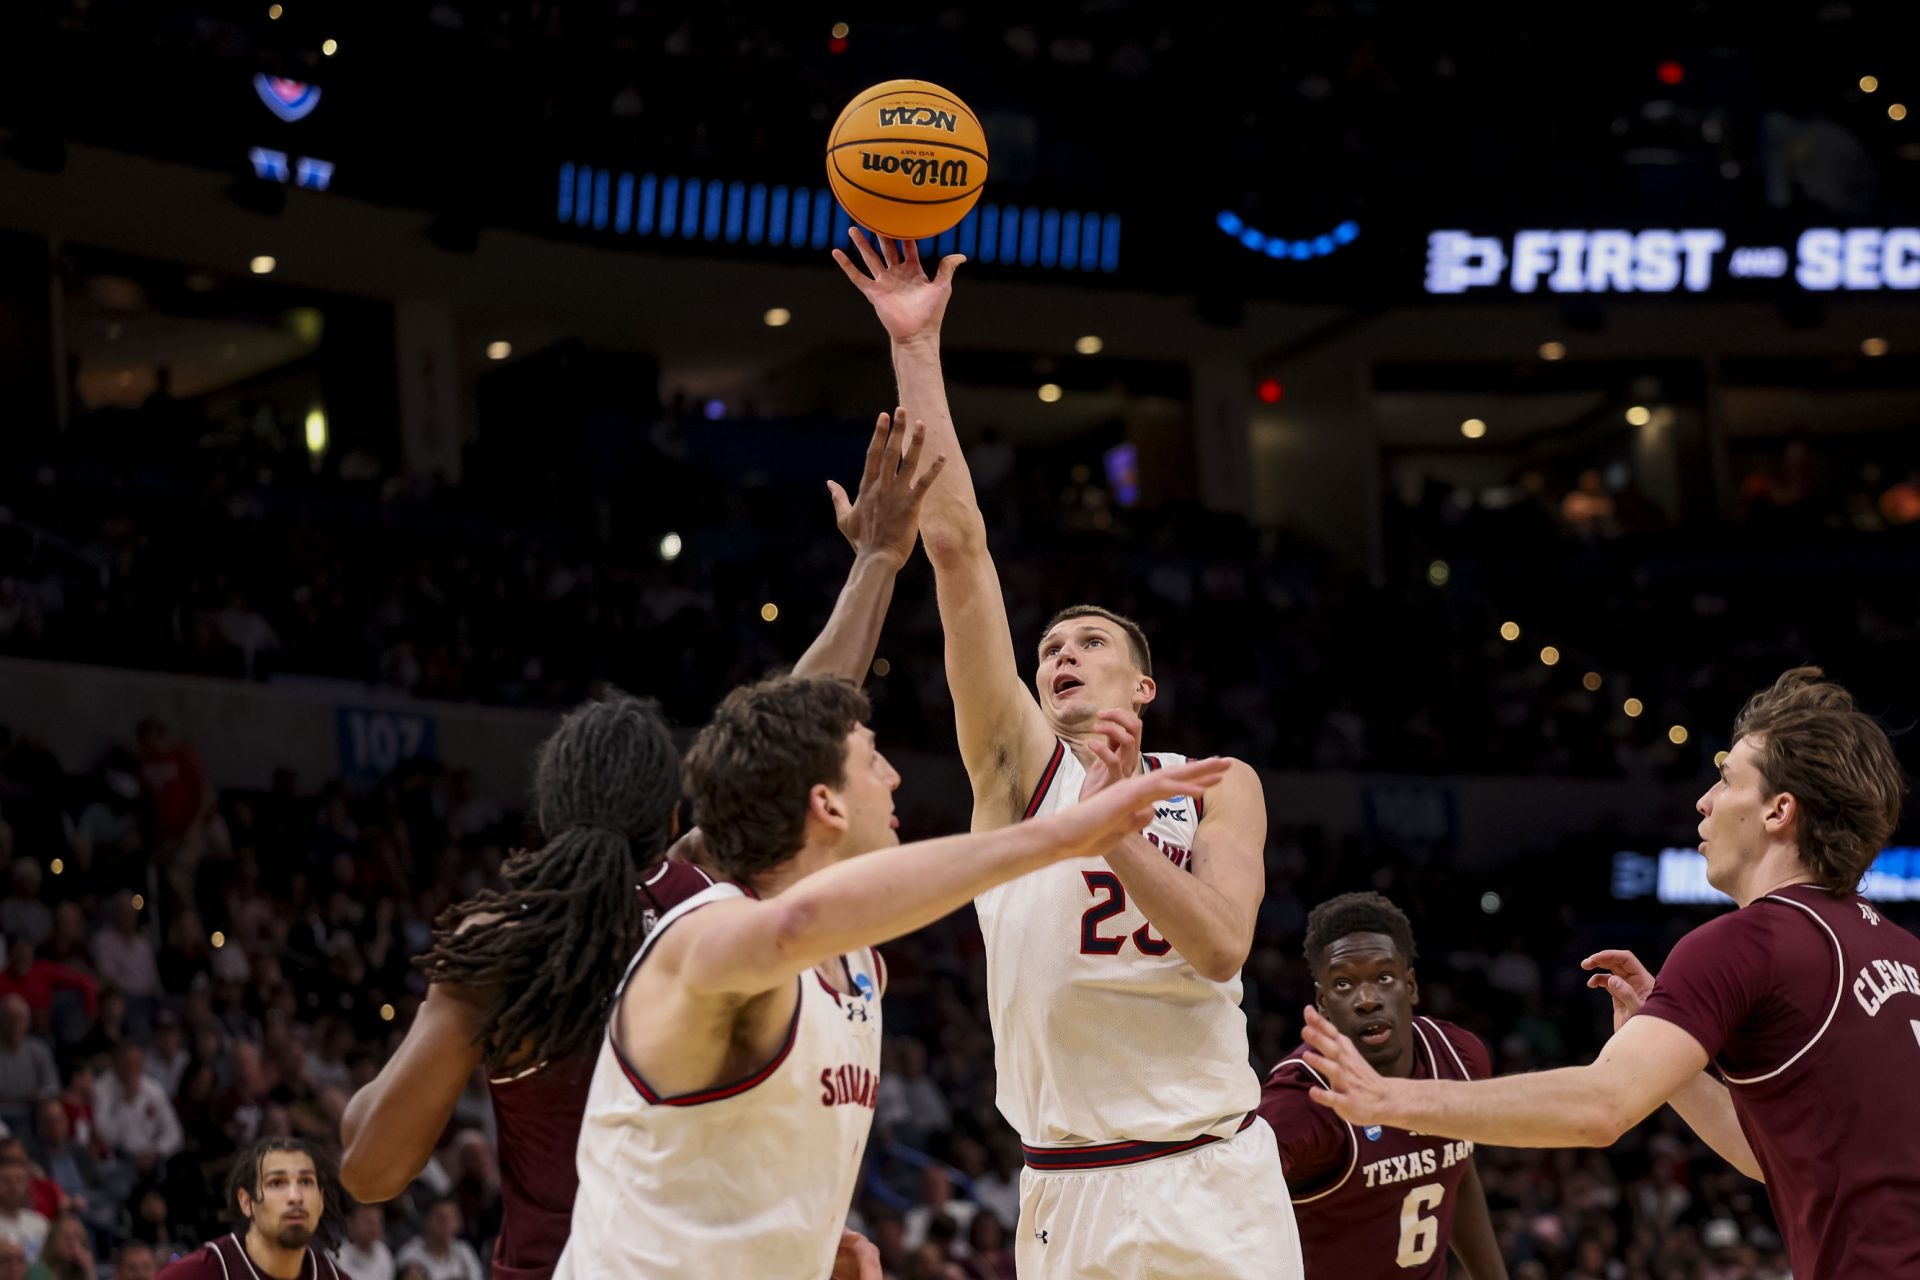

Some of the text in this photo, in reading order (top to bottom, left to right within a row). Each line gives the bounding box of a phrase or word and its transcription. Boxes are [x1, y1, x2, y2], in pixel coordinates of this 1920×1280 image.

[880, 107, 957, 132] NCAA
[862, 152, 968, 187] Wilson
[1511, 230, 1725, 293] FIRST
[347, 711, 424, 772] 107
[1363, 1148, 1437, 1188] TEXAS
[1396, 1182, 1446, 1269] 6
